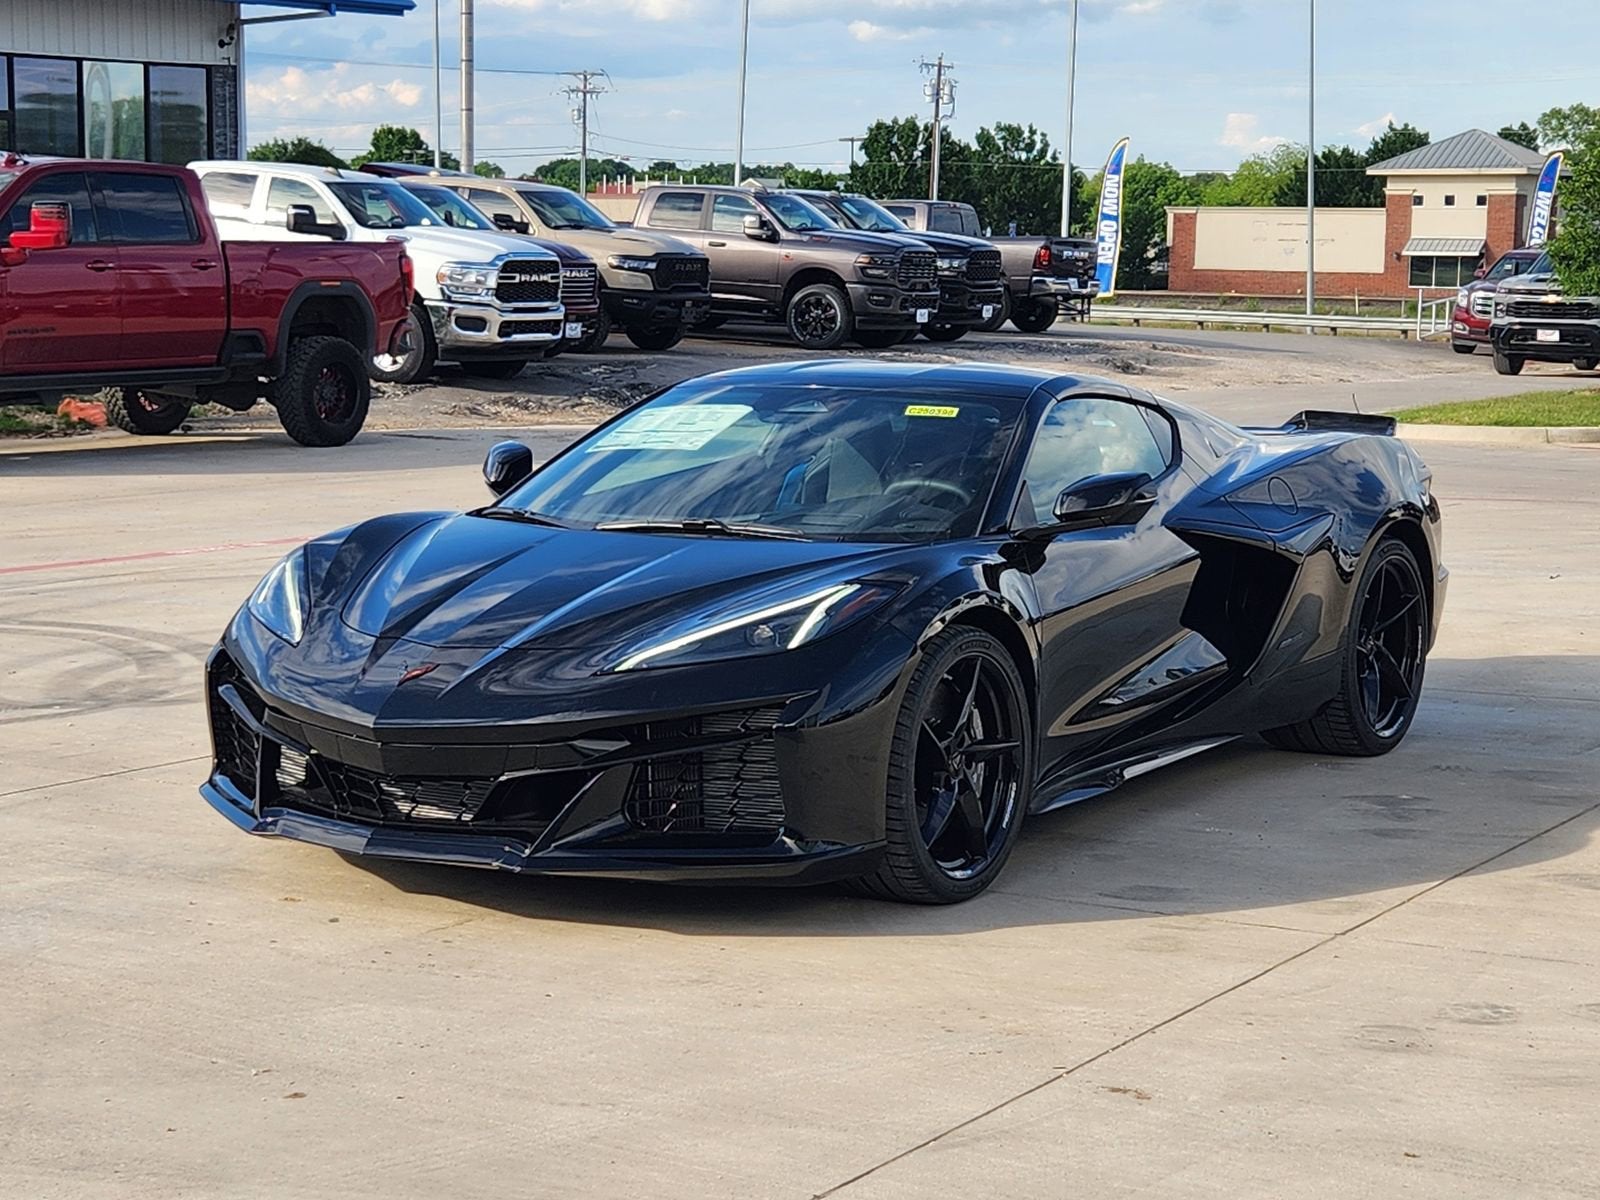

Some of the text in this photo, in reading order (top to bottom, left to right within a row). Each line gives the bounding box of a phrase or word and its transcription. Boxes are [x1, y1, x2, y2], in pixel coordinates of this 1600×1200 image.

[1097, 174, 1120, 264] NOW OPEN
[521, 273, 549, 282] RAM
